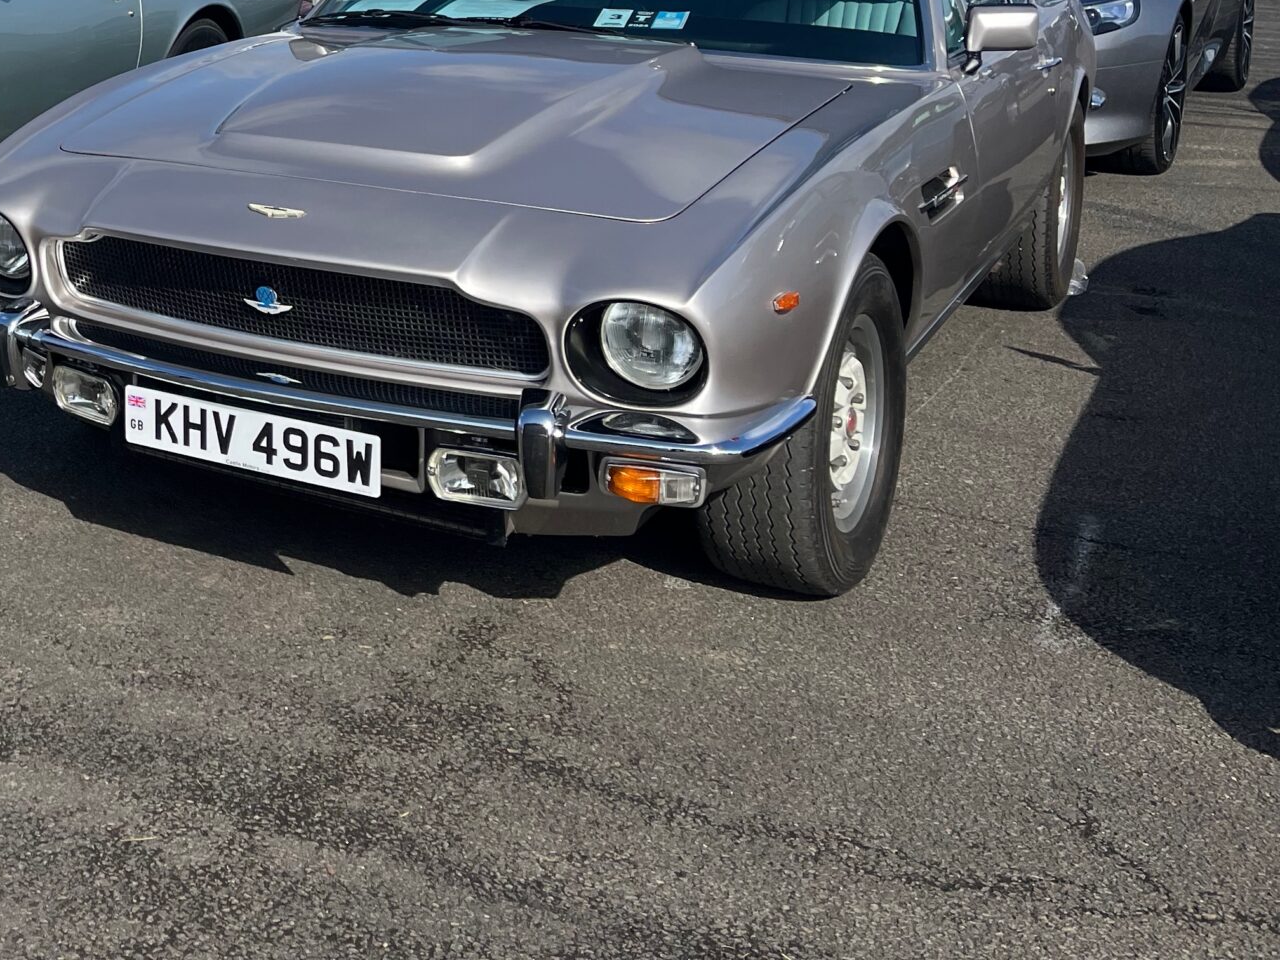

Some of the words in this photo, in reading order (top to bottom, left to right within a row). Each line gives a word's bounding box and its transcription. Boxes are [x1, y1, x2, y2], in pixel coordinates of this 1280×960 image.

[130, 418, 144, 431] GB
[154, 398, 237, 456] KHV
[252, 422, 373, 487] 496W
